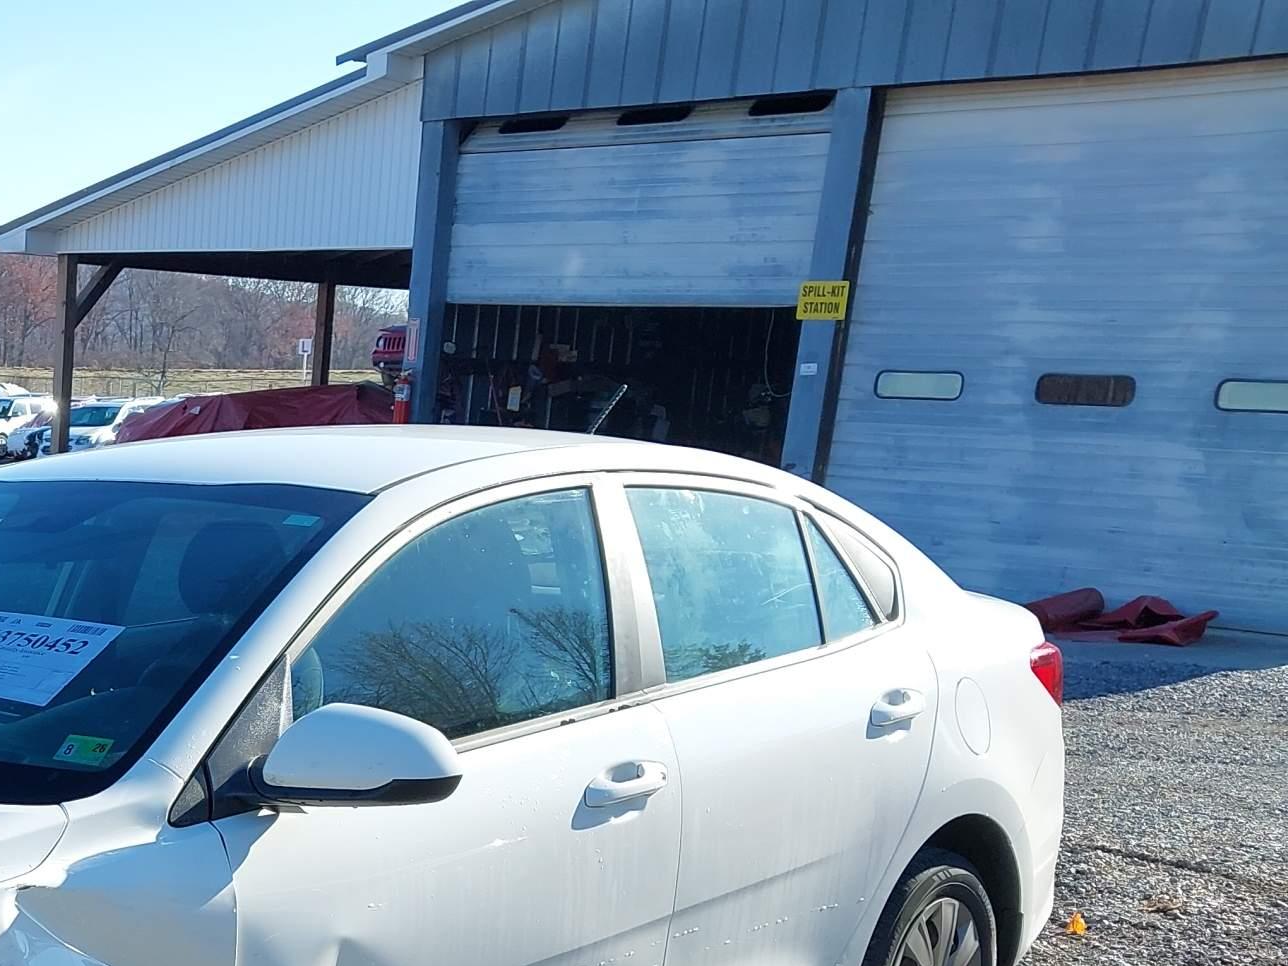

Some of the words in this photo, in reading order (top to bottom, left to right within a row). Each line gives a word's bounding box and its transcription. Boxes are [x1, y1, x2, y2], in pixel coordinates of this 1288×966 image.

[802, 285, 846, 298] SPILL-KIT
[802, 301, 840, 314] STATION
[301, 340, 309, 353] L
[63, 743, 74, 756] 8
